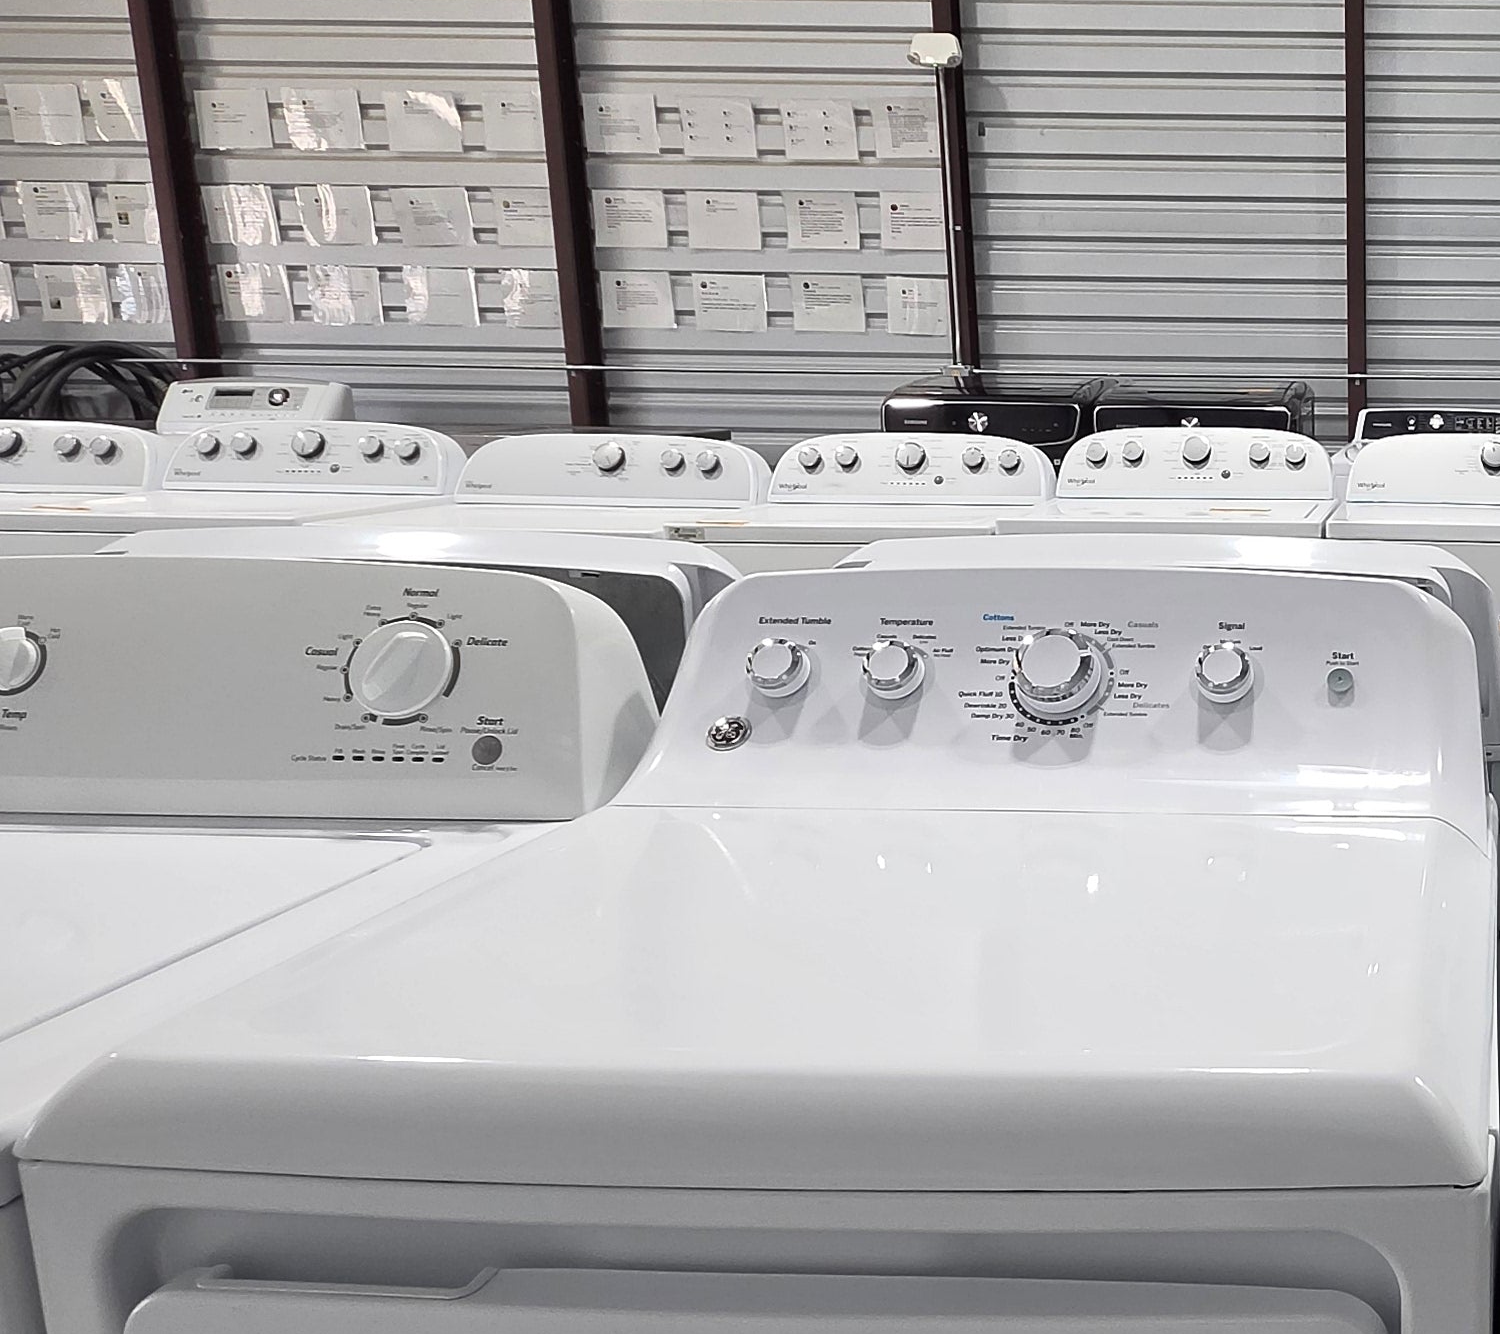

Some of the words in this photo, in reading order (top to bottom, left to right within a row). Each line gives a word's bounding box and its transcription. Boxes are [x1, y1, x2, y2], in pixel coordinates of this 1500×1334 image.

[1067, 478, 1096, 487] Whirlpool
[1357, 482, 1386, 490] Whirlpool
[779, 483, 808, 491] Whirlpool
[402, 588, 440, 597] Normal
[758, 617, 799, 625] Extended
[801, 617, 832, 625] Tumble
[983, 613, 1015, 621] Cottons
[880, 618, 934, 626] Temperature
[1098, 621, 1110, 629] Dry
[1128, 620, 1159, 628] Casuals
[1219, 622, 1245, 631] Signal
[466, 637, 508, 647] Delicate
[305, 647, 339, 656] Casual
[976, 646, 1006, 654] Optimum
[1332, 652, 1354, 660] Start
[998, 658, 1010, 667] Dry
[1135, 681, 1148, 690] Dry
[1130, 693, 1142, 701] Dry
[2, 708, 27, 721] Temp
[991, 713, 1003, 721] Dry
[477, 716, 504, 726] Start
[992, 734, 1011, 742] Time
[1013, 734, 1029, 743] Dry
